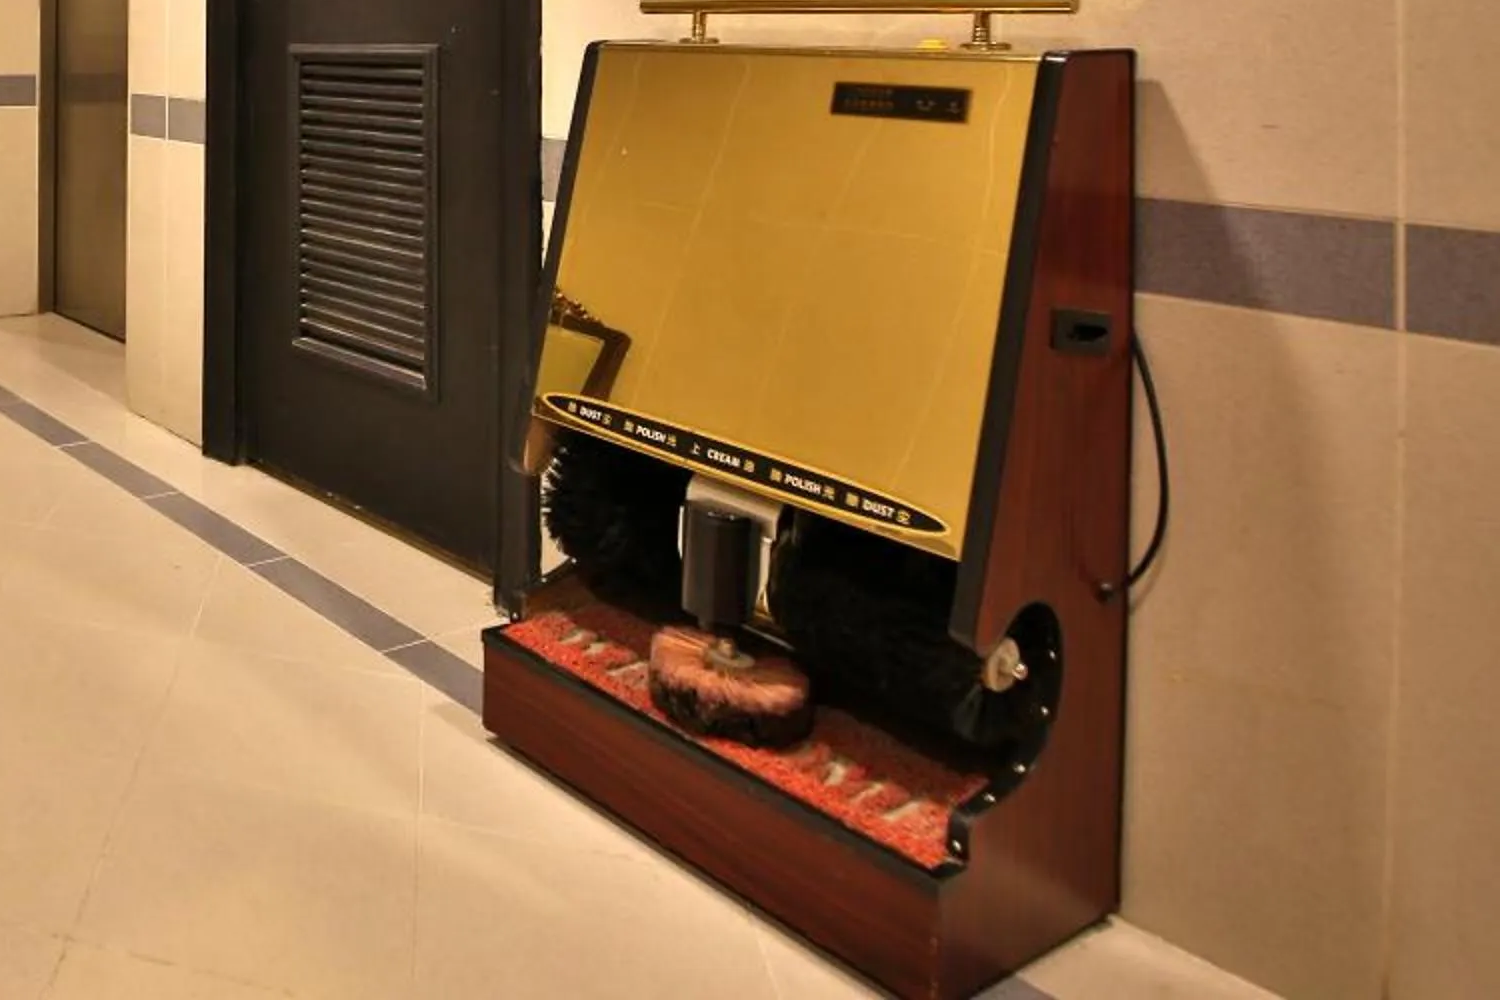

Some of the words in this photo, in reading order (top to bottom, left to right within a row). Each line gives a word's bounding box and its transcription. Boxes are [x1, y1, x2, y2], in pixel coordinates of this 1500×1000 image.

[579, 405, 602, 421] DUST
[635, 425, 667, 443] POLISH
[707, 448, 741, 468] CREAM
[784, 473, 822, 496] POLISH
[862, 497, 896, 519] DUST
